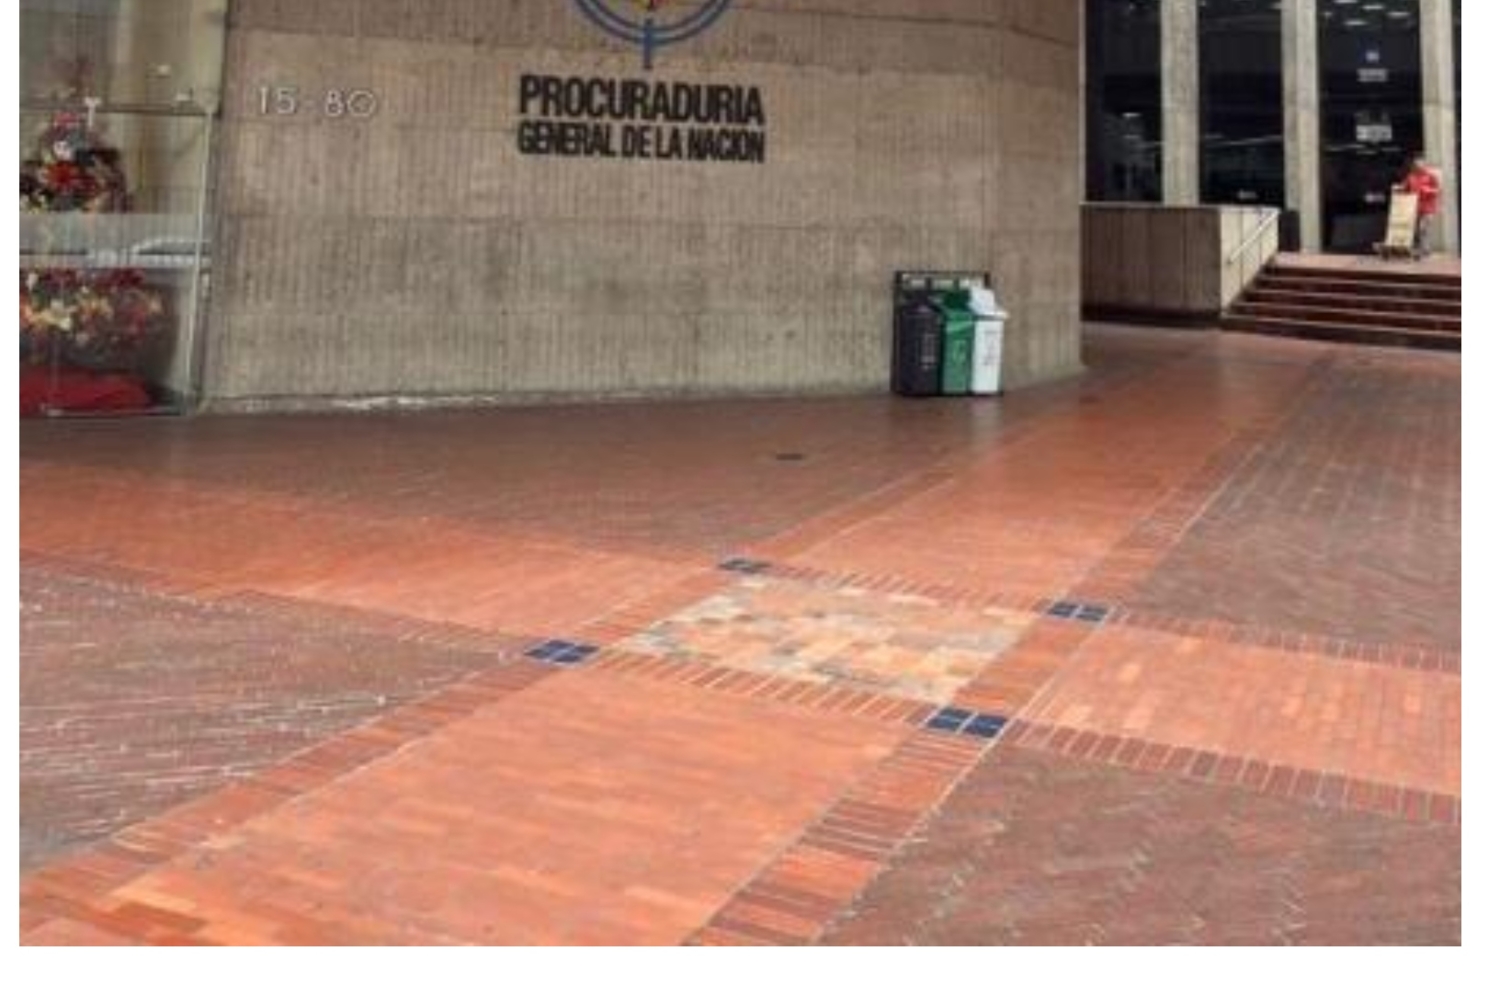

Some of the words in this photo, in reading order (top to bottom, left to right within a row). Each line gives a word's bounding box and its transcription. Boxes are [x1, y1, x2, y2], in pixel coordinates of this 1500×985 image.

[519, 74, 766, 125] PROCURADURIA
[518, 120, 617, 157] GENERAL
[621, 124, 651, 158] DE
[655, 126, 682, 160] LA
[687, 127, 765, 163] NACION
